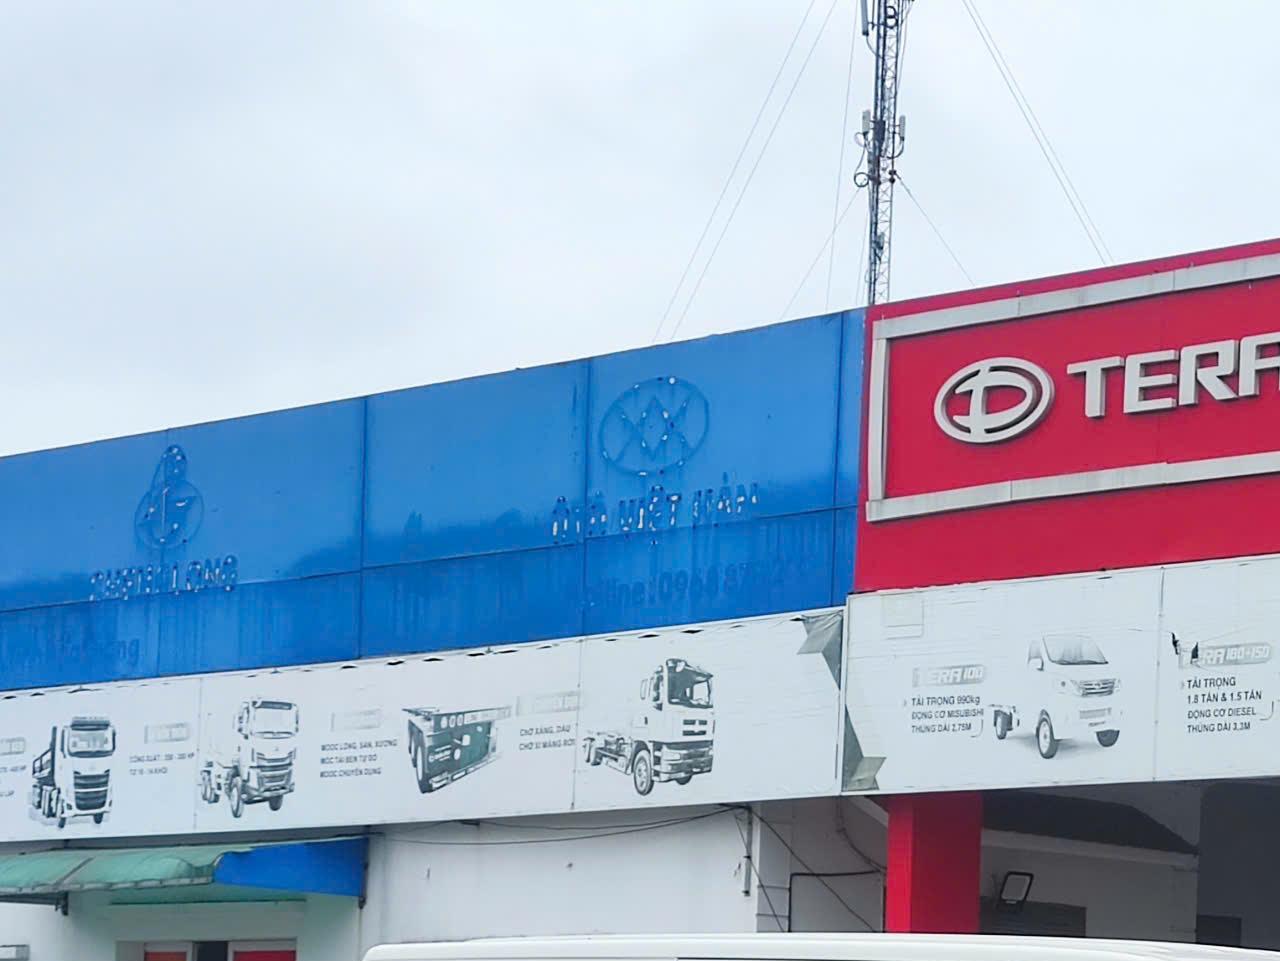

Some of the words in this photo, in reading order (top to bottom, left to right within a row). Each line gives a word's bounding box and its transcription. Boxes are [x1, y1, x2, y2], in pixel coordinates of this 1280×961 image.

[1187, 676, 1202, 688] TẢI
[1204, 676, 1237, 689] TRỌNG
[1220, 692, 1227, 702] &
[1228, 706, 1257, 716] DIESEL
